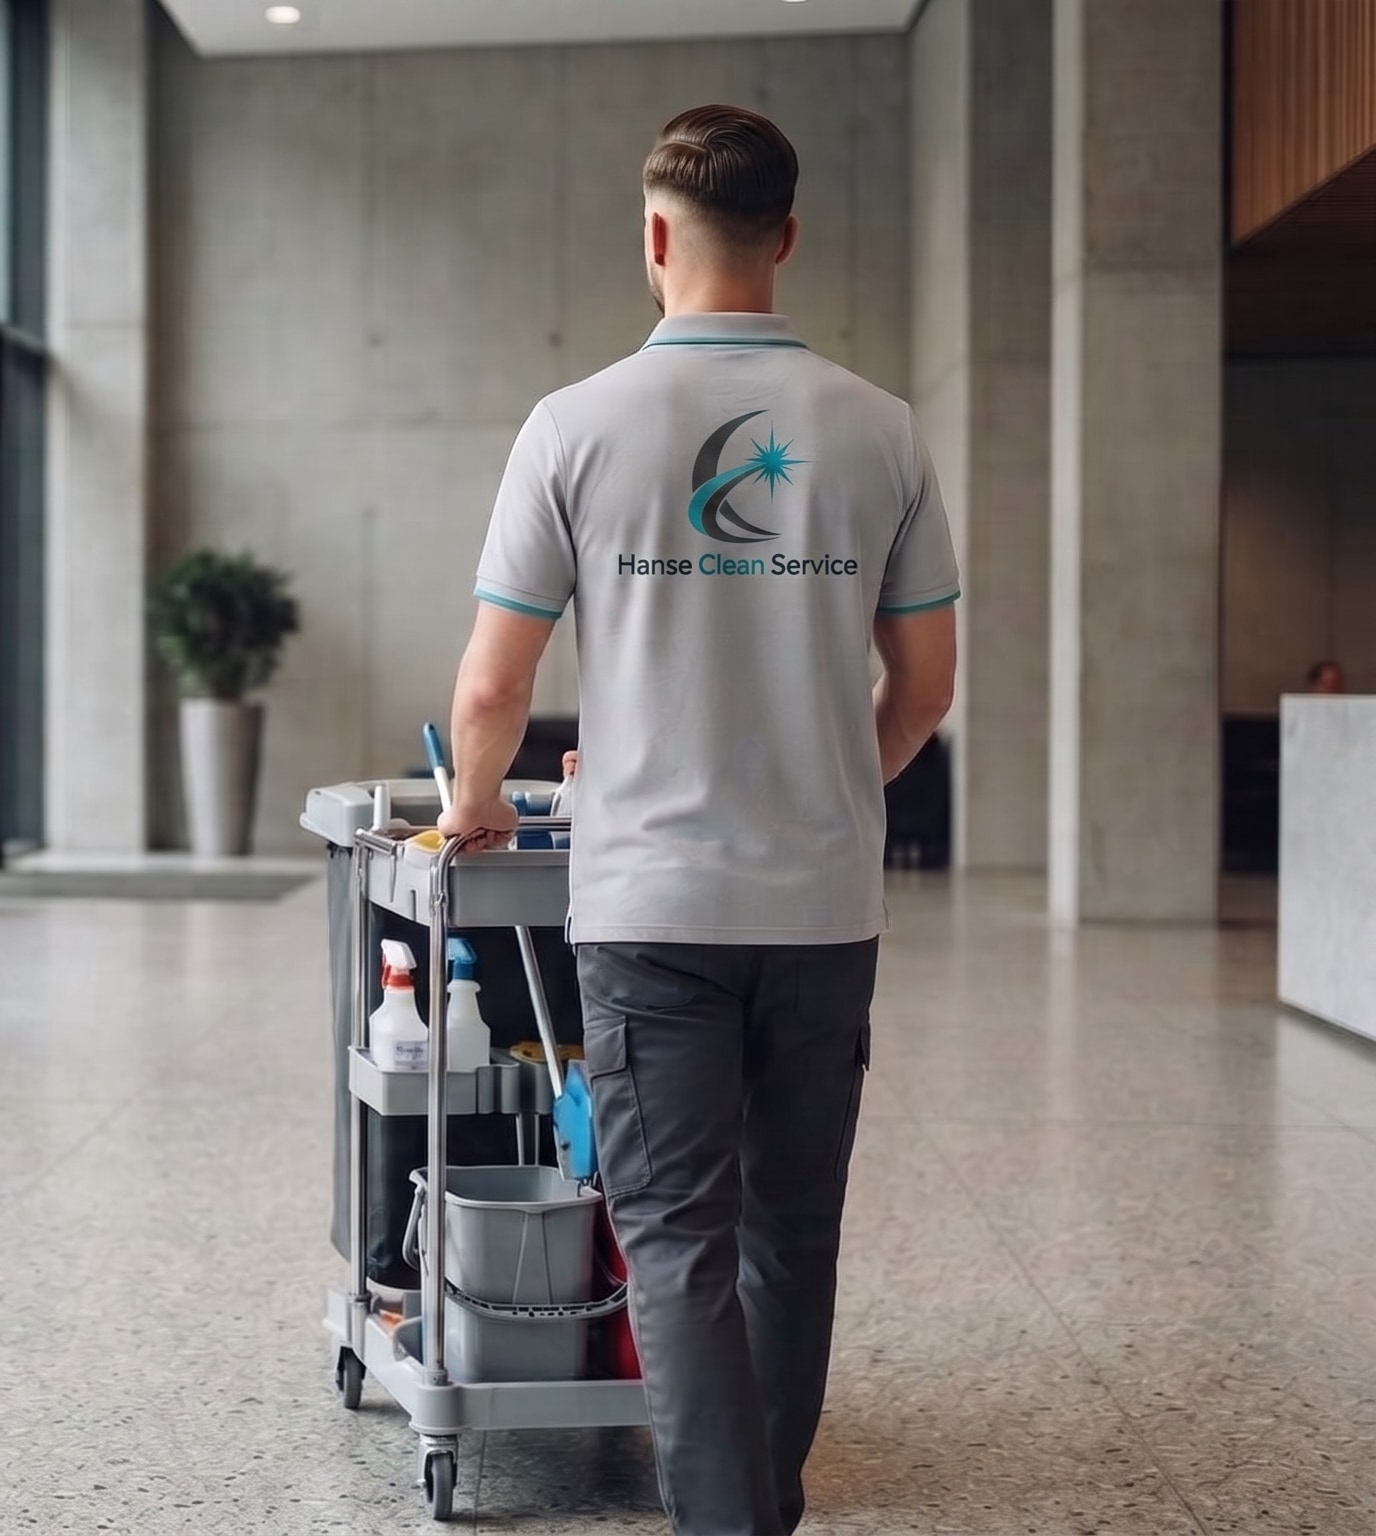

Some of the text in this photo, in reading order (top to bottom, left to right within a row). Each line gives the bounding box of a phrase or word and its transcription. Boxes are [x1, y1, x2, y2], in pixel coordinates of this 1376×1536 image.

[617, 553, 858, 576] Hanse Clean Service
